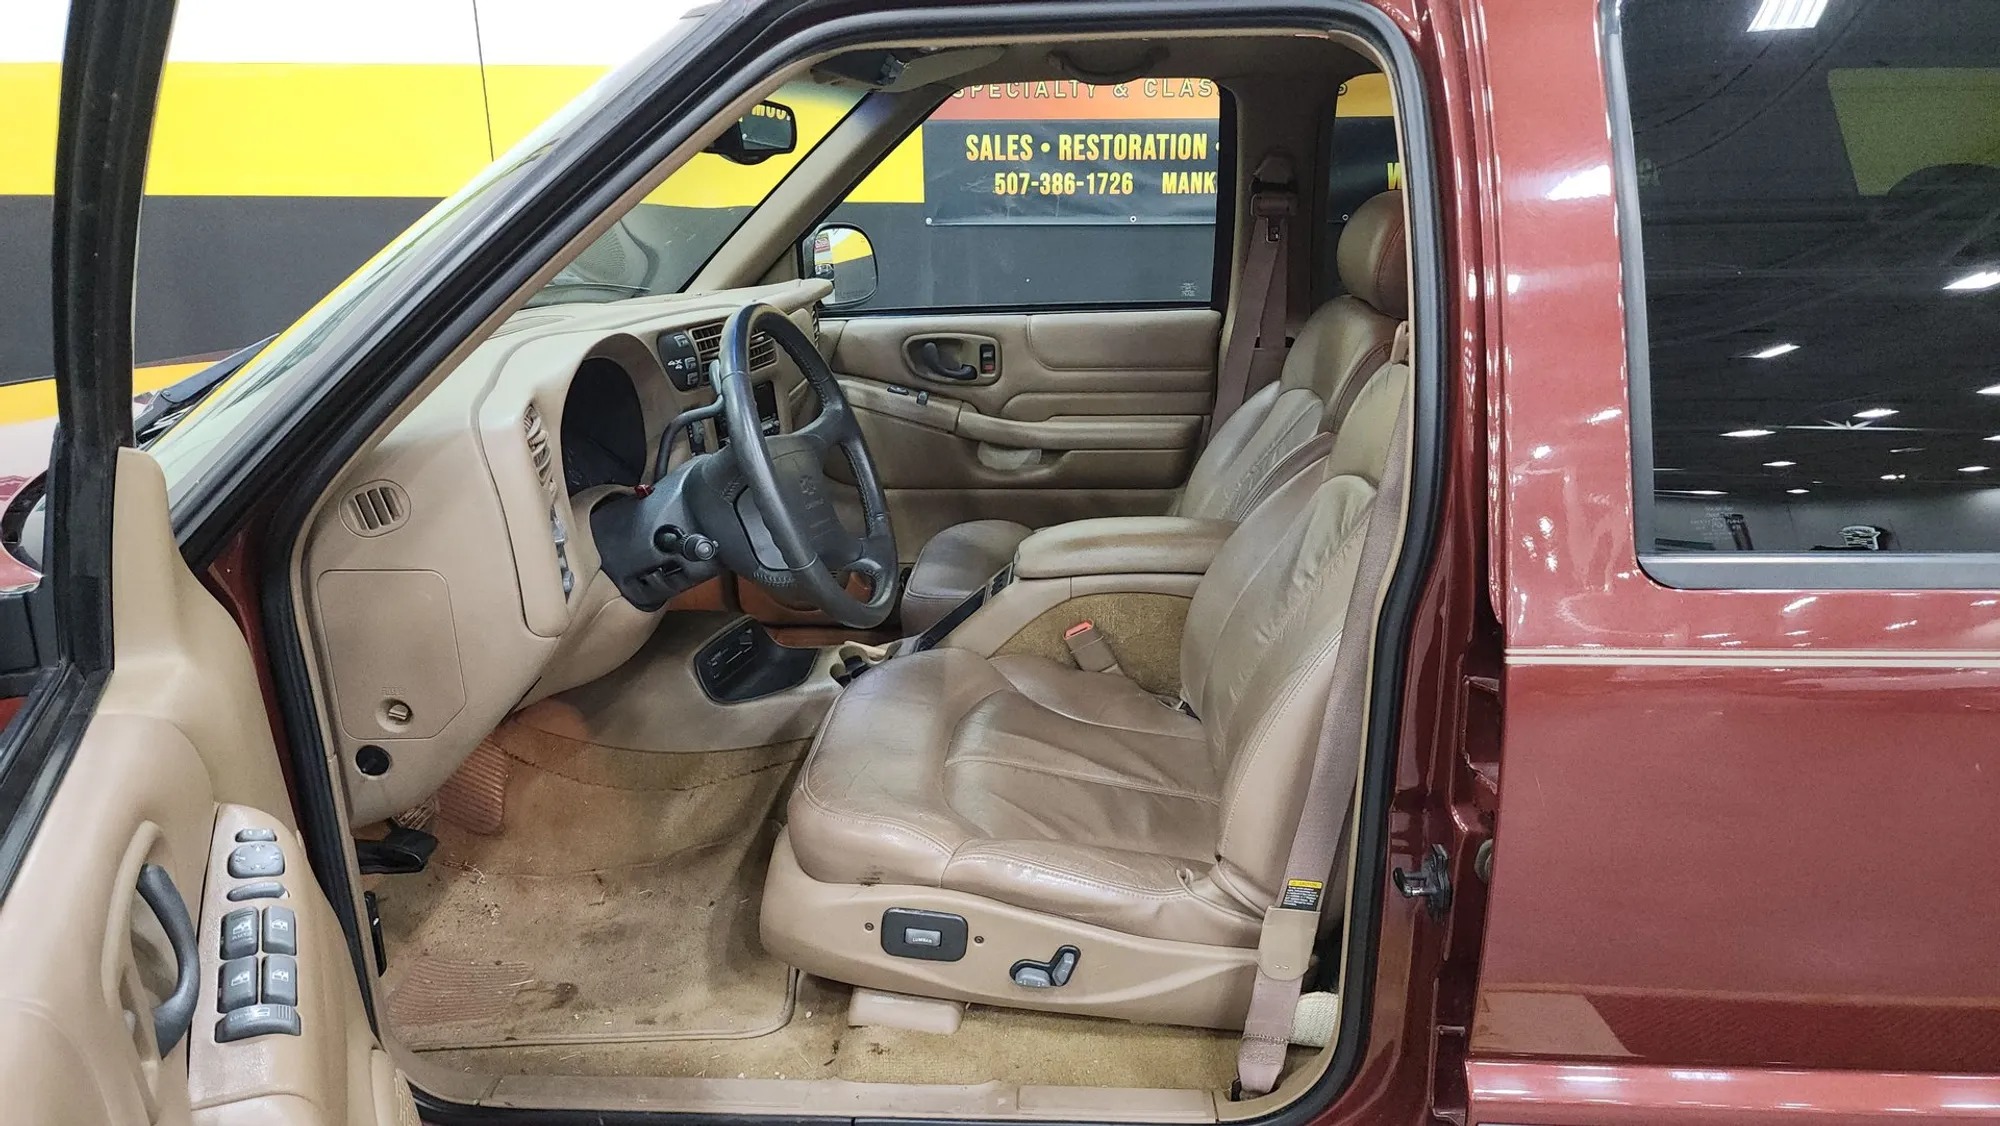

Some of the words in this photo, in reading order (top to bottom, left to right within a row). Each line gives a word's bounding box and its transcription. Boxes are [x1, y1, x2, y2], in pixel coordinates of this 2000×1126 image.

[1114, 84, 1129, 98] &
[1144, 78, 1219, 98] CLAS
[965, 133, 1034, 161] SALES
[1058, 133, 1208, 161] RESTORATION
[994, 171, 1134, 195] 507-386-1726
[1162, 171, 1218, 194] MANK
